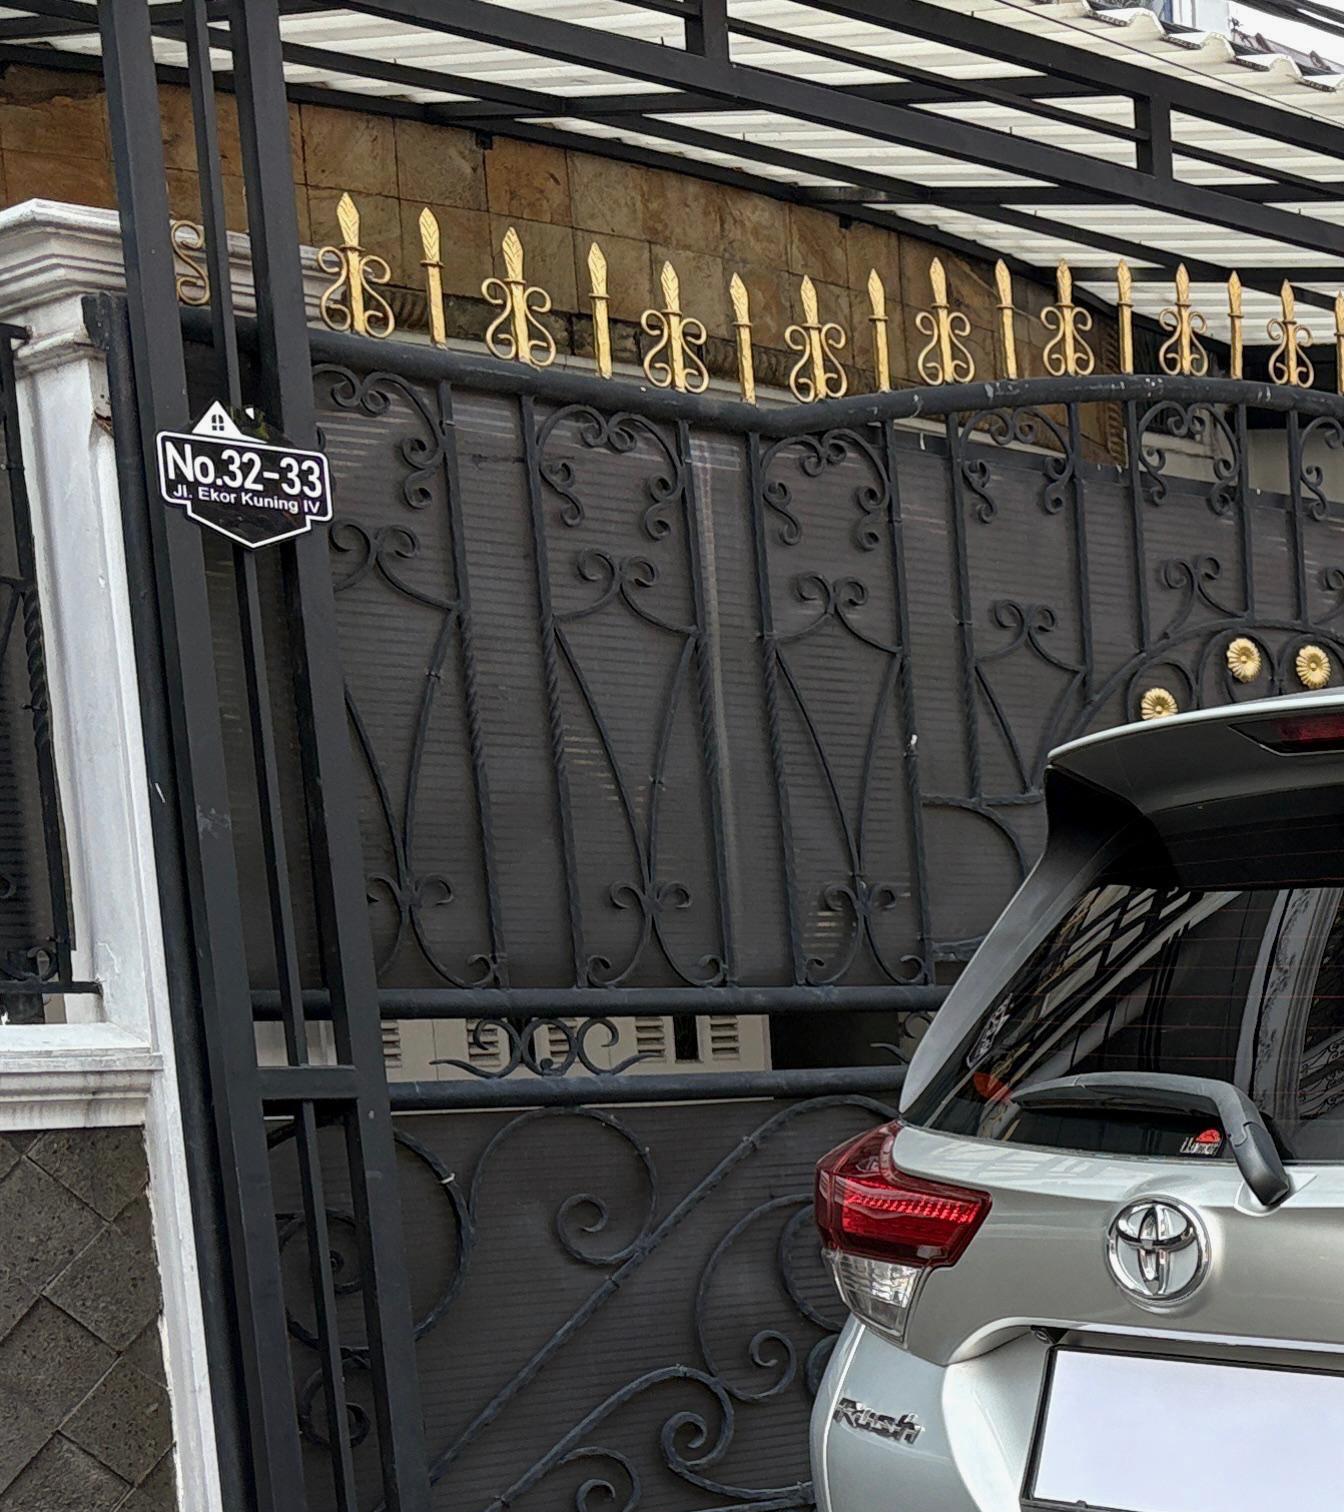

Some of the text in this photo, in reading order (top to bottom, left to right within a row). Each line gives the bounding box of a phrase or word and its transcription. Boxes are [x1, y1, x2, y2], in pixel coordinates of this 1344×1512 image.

[164, 441, 323, 498] No.32-33
[173, 484, 320, 514] Jl. Ekor Kuning IV
[832, 1397, 924, 1445] Rush
